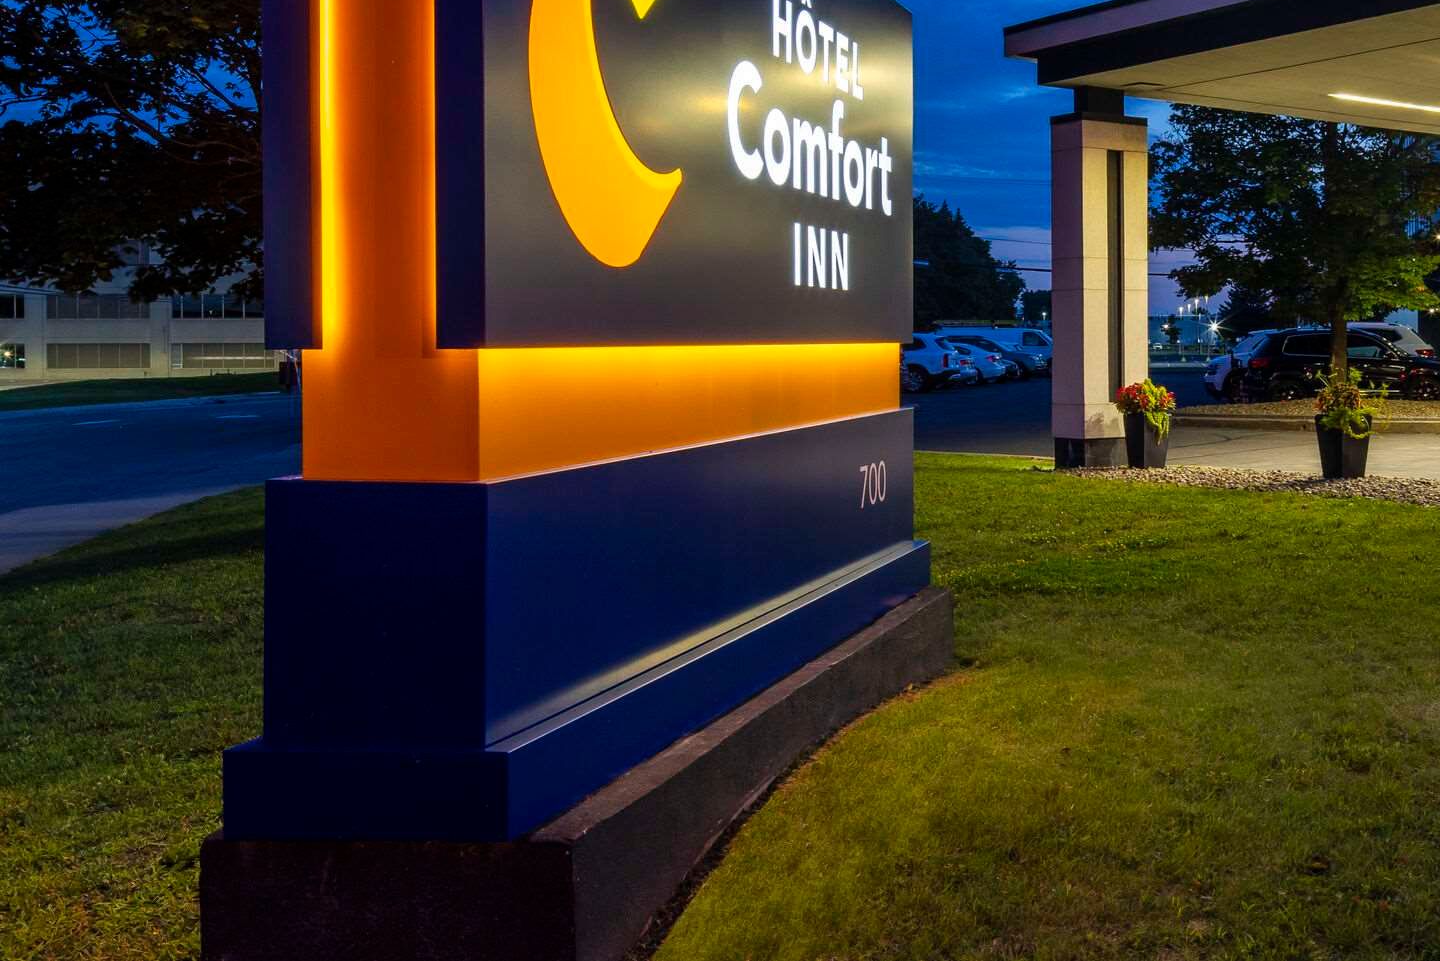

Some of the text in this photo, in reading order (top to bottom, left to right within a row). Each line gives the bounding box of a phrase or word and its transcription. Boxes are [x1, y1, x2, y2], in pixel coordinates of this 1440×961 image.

[727, 60, 892, 216] Comfort
[794, 222, 848, 291] INN
[860, 460, 886, 509] 700
